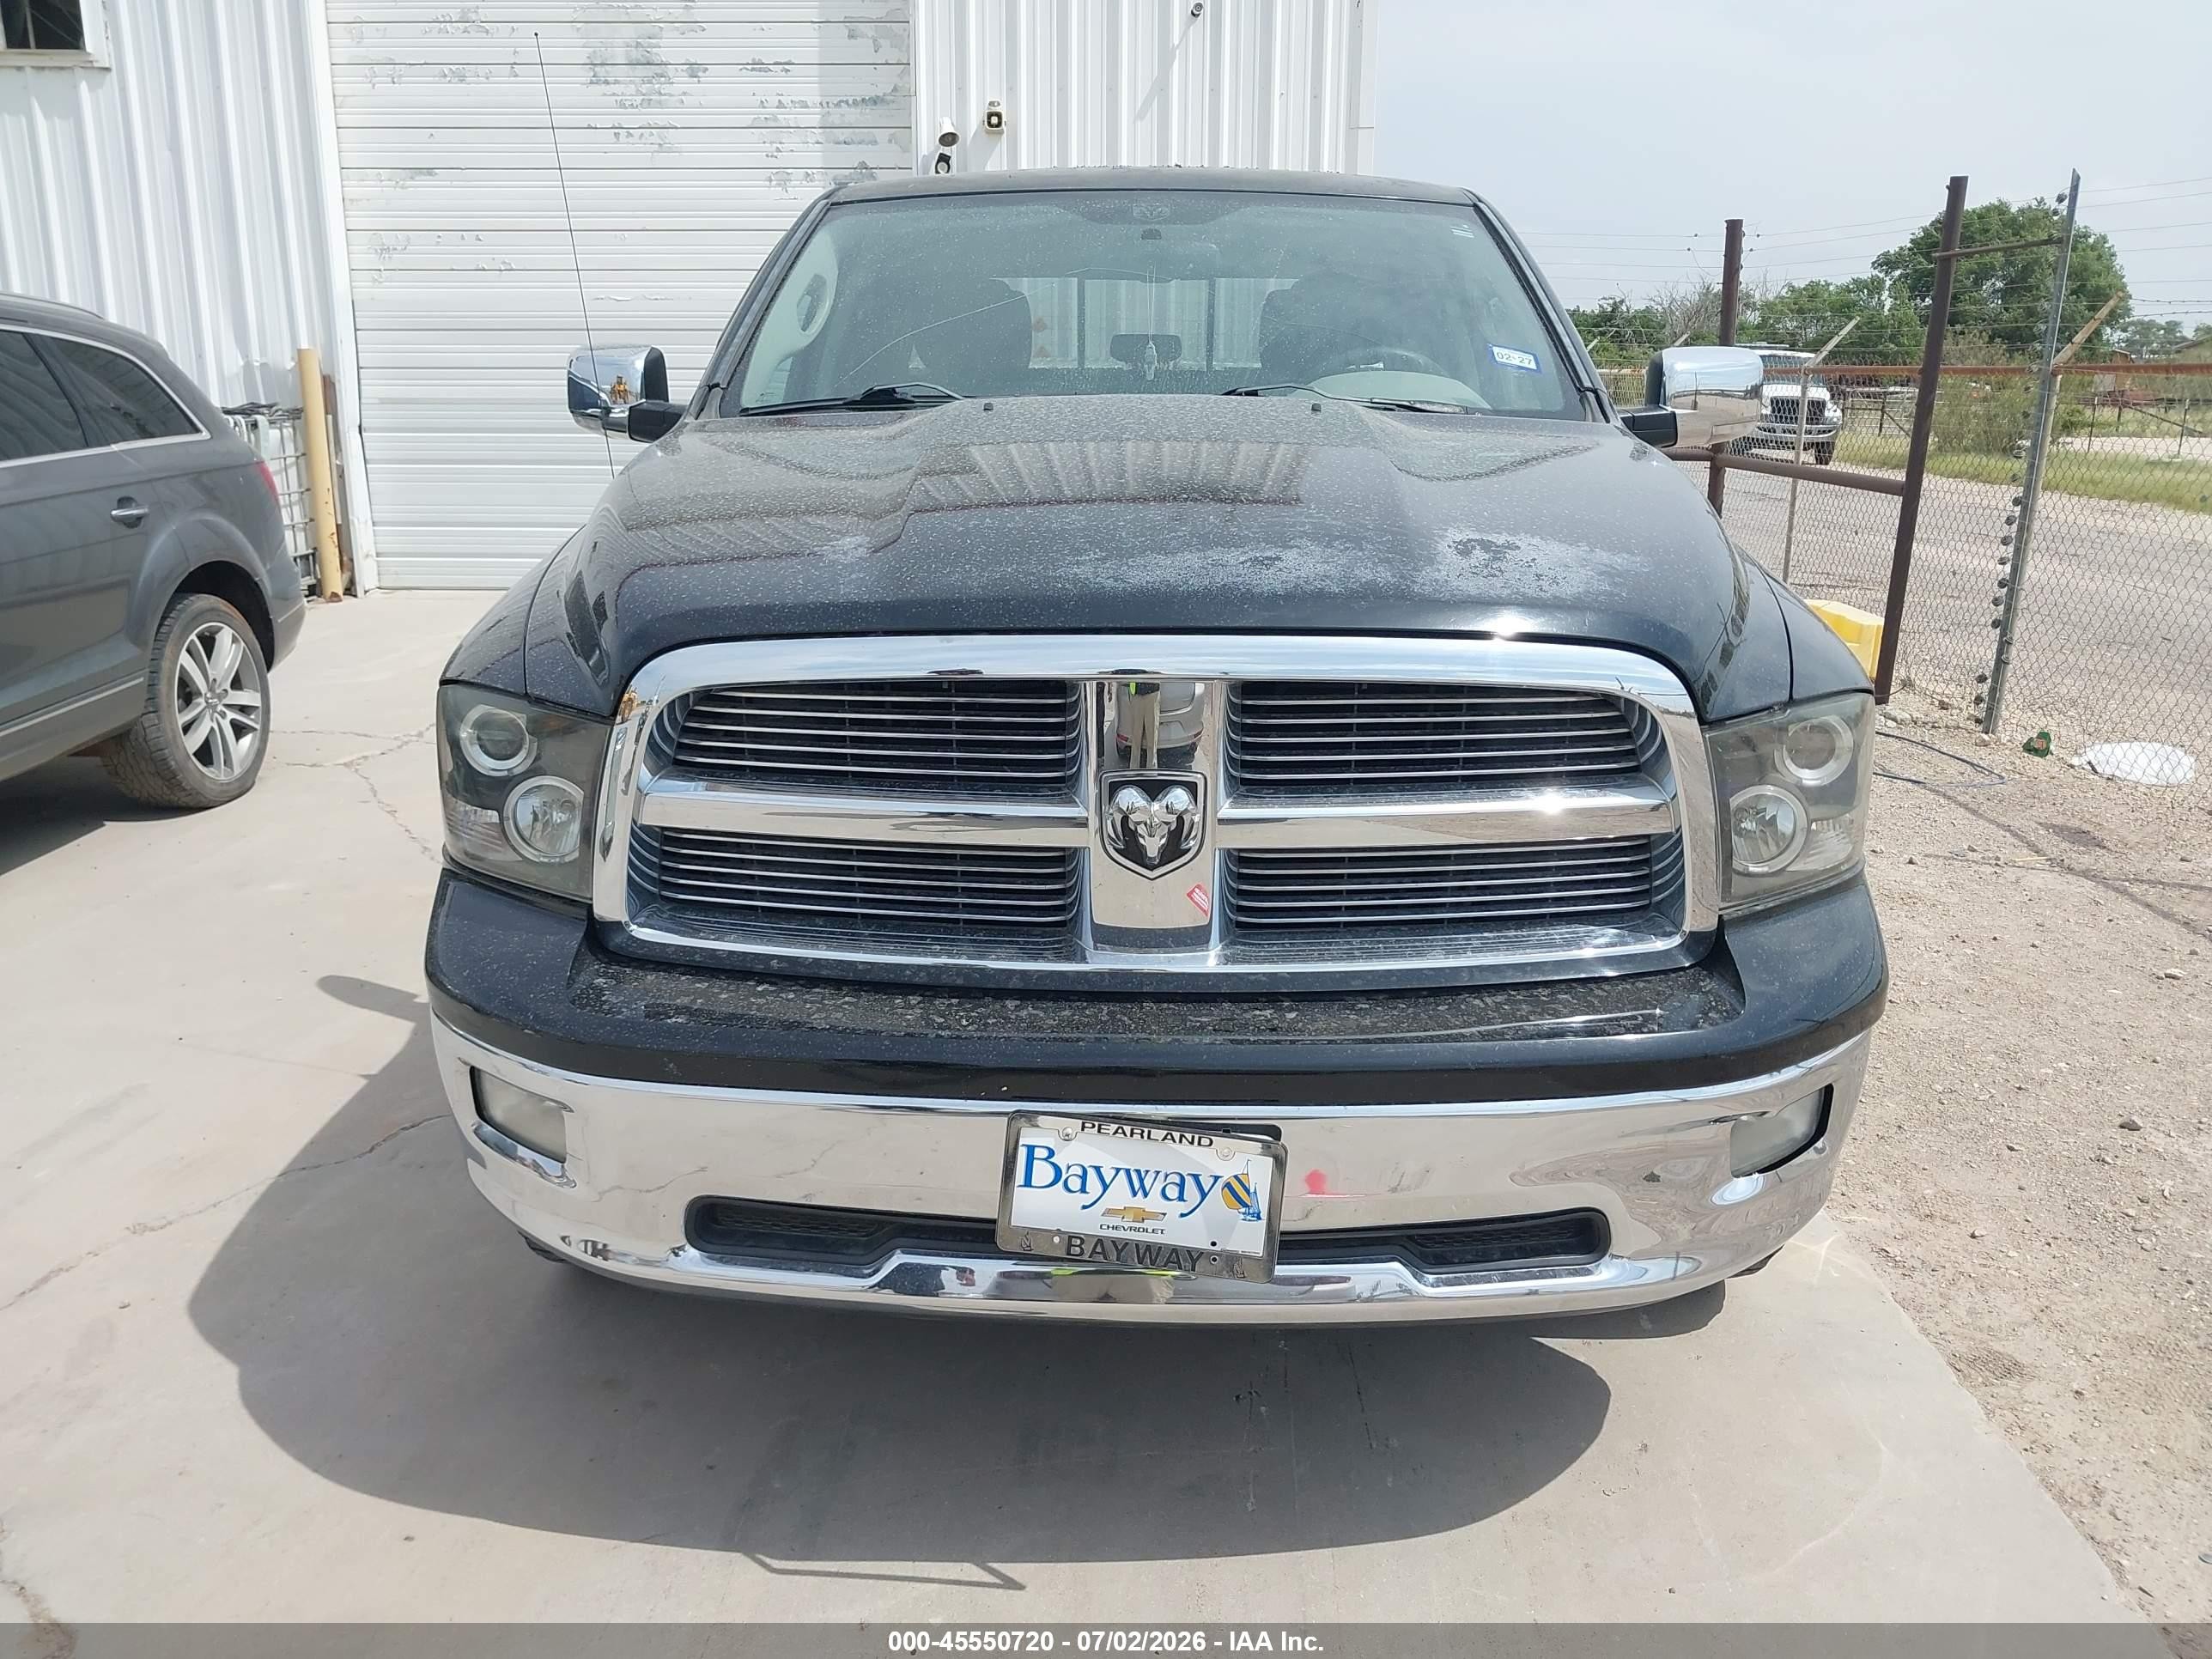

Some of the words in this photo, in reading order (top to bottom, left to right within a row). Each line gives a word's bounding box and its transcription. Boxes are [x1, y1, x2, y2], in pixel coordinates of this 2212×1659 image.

[1080, 1121, 1214, 1147] PEARLAND
[1016, 1143, 1224, 1218] Bayway
[1099, 1223, 1166, 1235] CHEVROLET
[1066, 1235, 1204, 1272] BAYWAY
